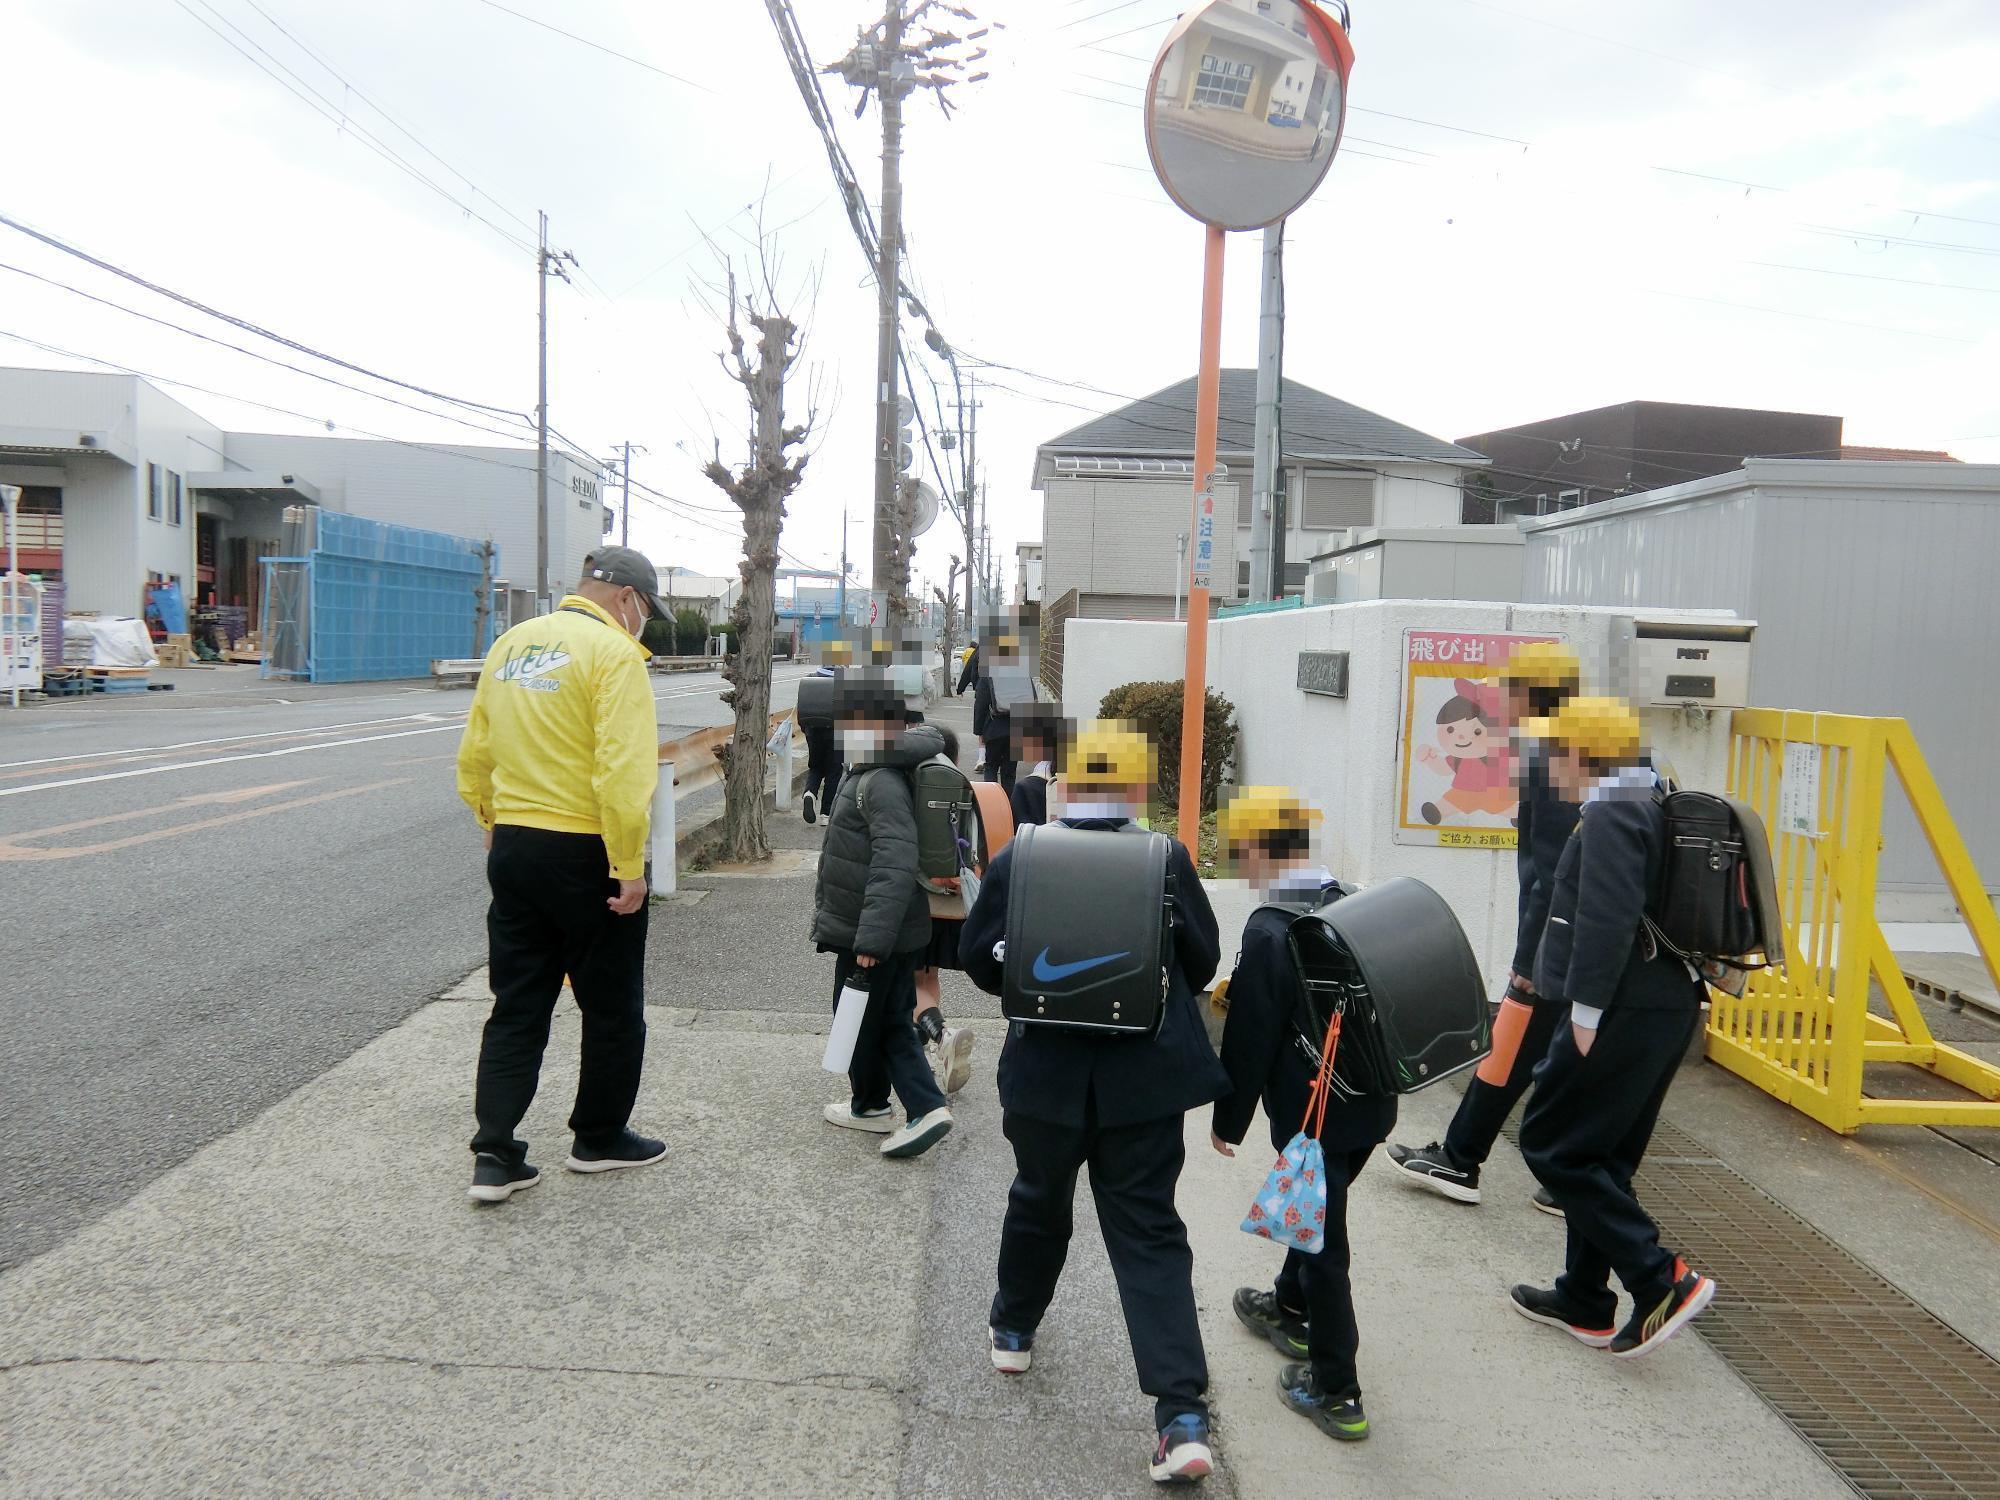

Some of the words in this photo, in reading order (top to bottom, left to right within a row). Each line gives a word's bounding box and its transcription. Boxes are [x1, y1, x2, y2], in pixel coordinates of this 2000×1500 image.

[1199, 517, 1212, 560] 注意
[504, 641, 567, 683] WELL
[1677, 647, 1710, 661] POST
